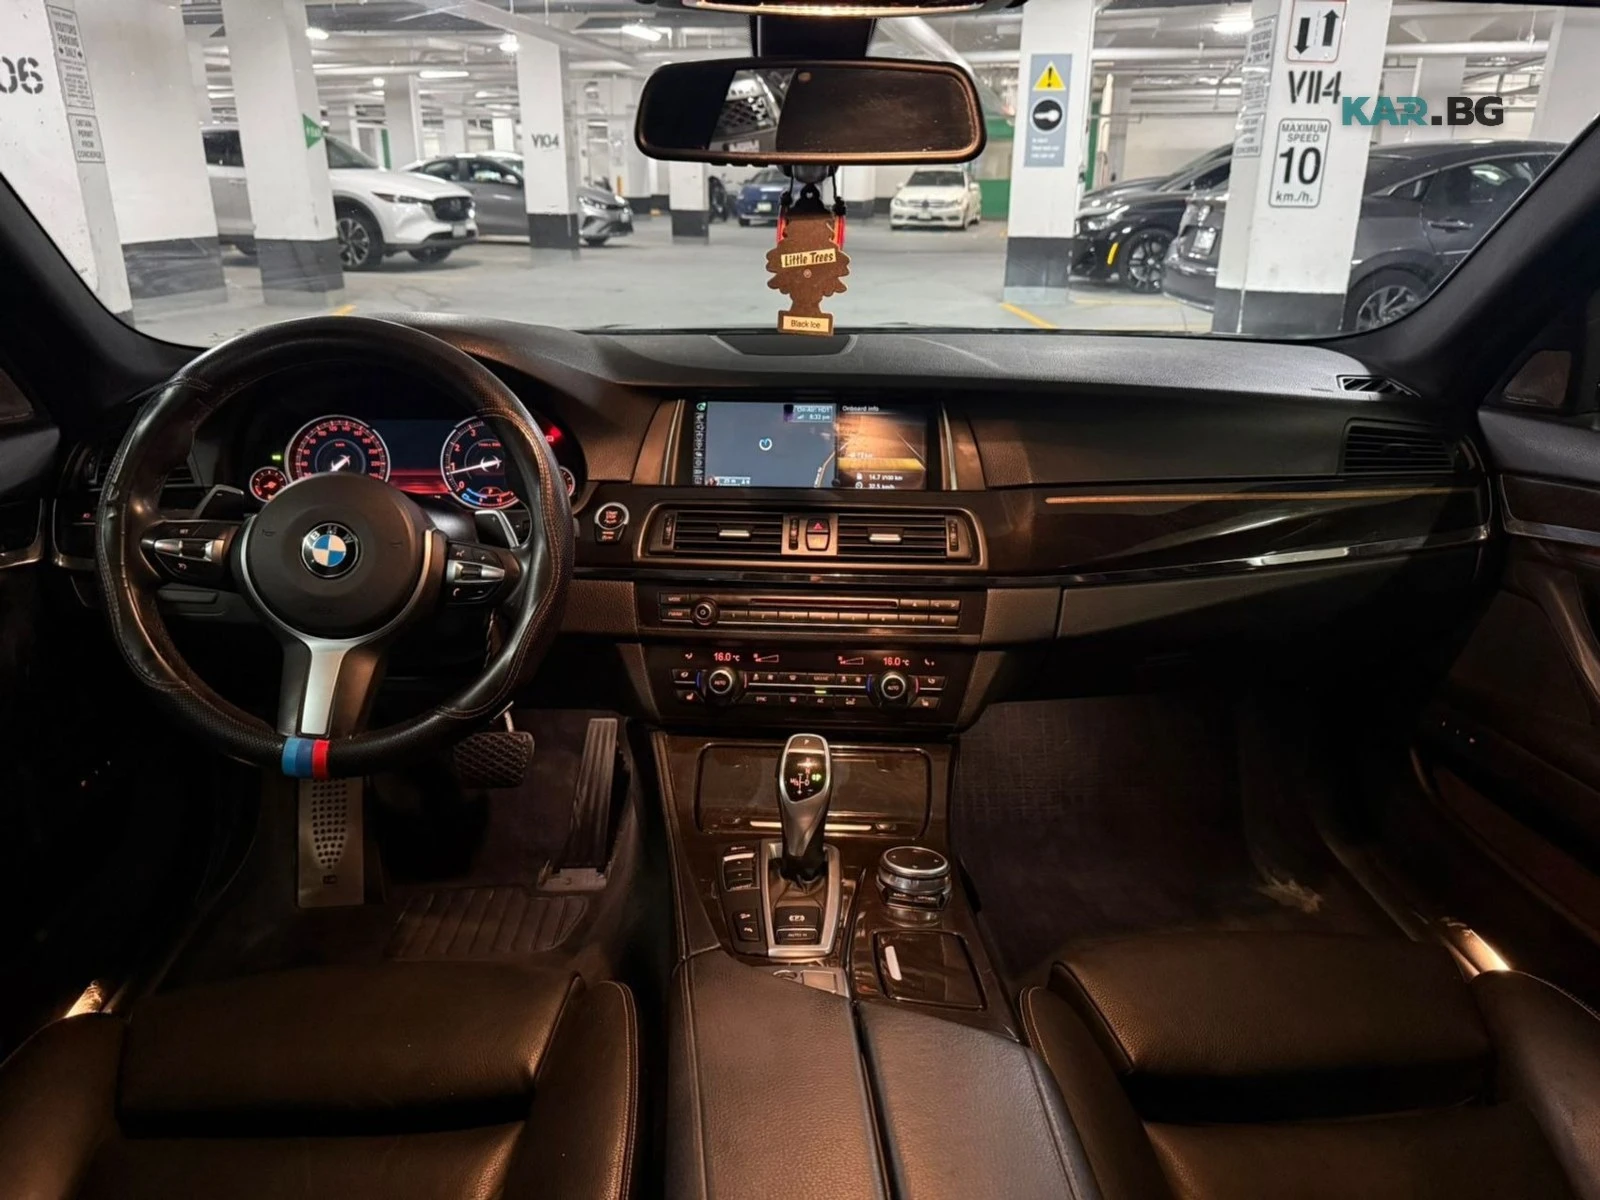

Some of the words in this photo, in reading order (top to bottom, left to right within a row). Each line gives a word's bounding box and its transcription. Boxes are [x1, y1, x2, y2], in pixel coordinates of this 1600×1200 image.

[1281, 124, 1328, 133] MAXIMUM
[1287, 133, 1320, 143] SPEED
[1279, 147, 1321, 185] 10
[784, 254, 808, 267] Little
[809, 252, 834, 264] Trees
[791, 320, 809, 328] Black
[810, 321, 821, 329] Ice
